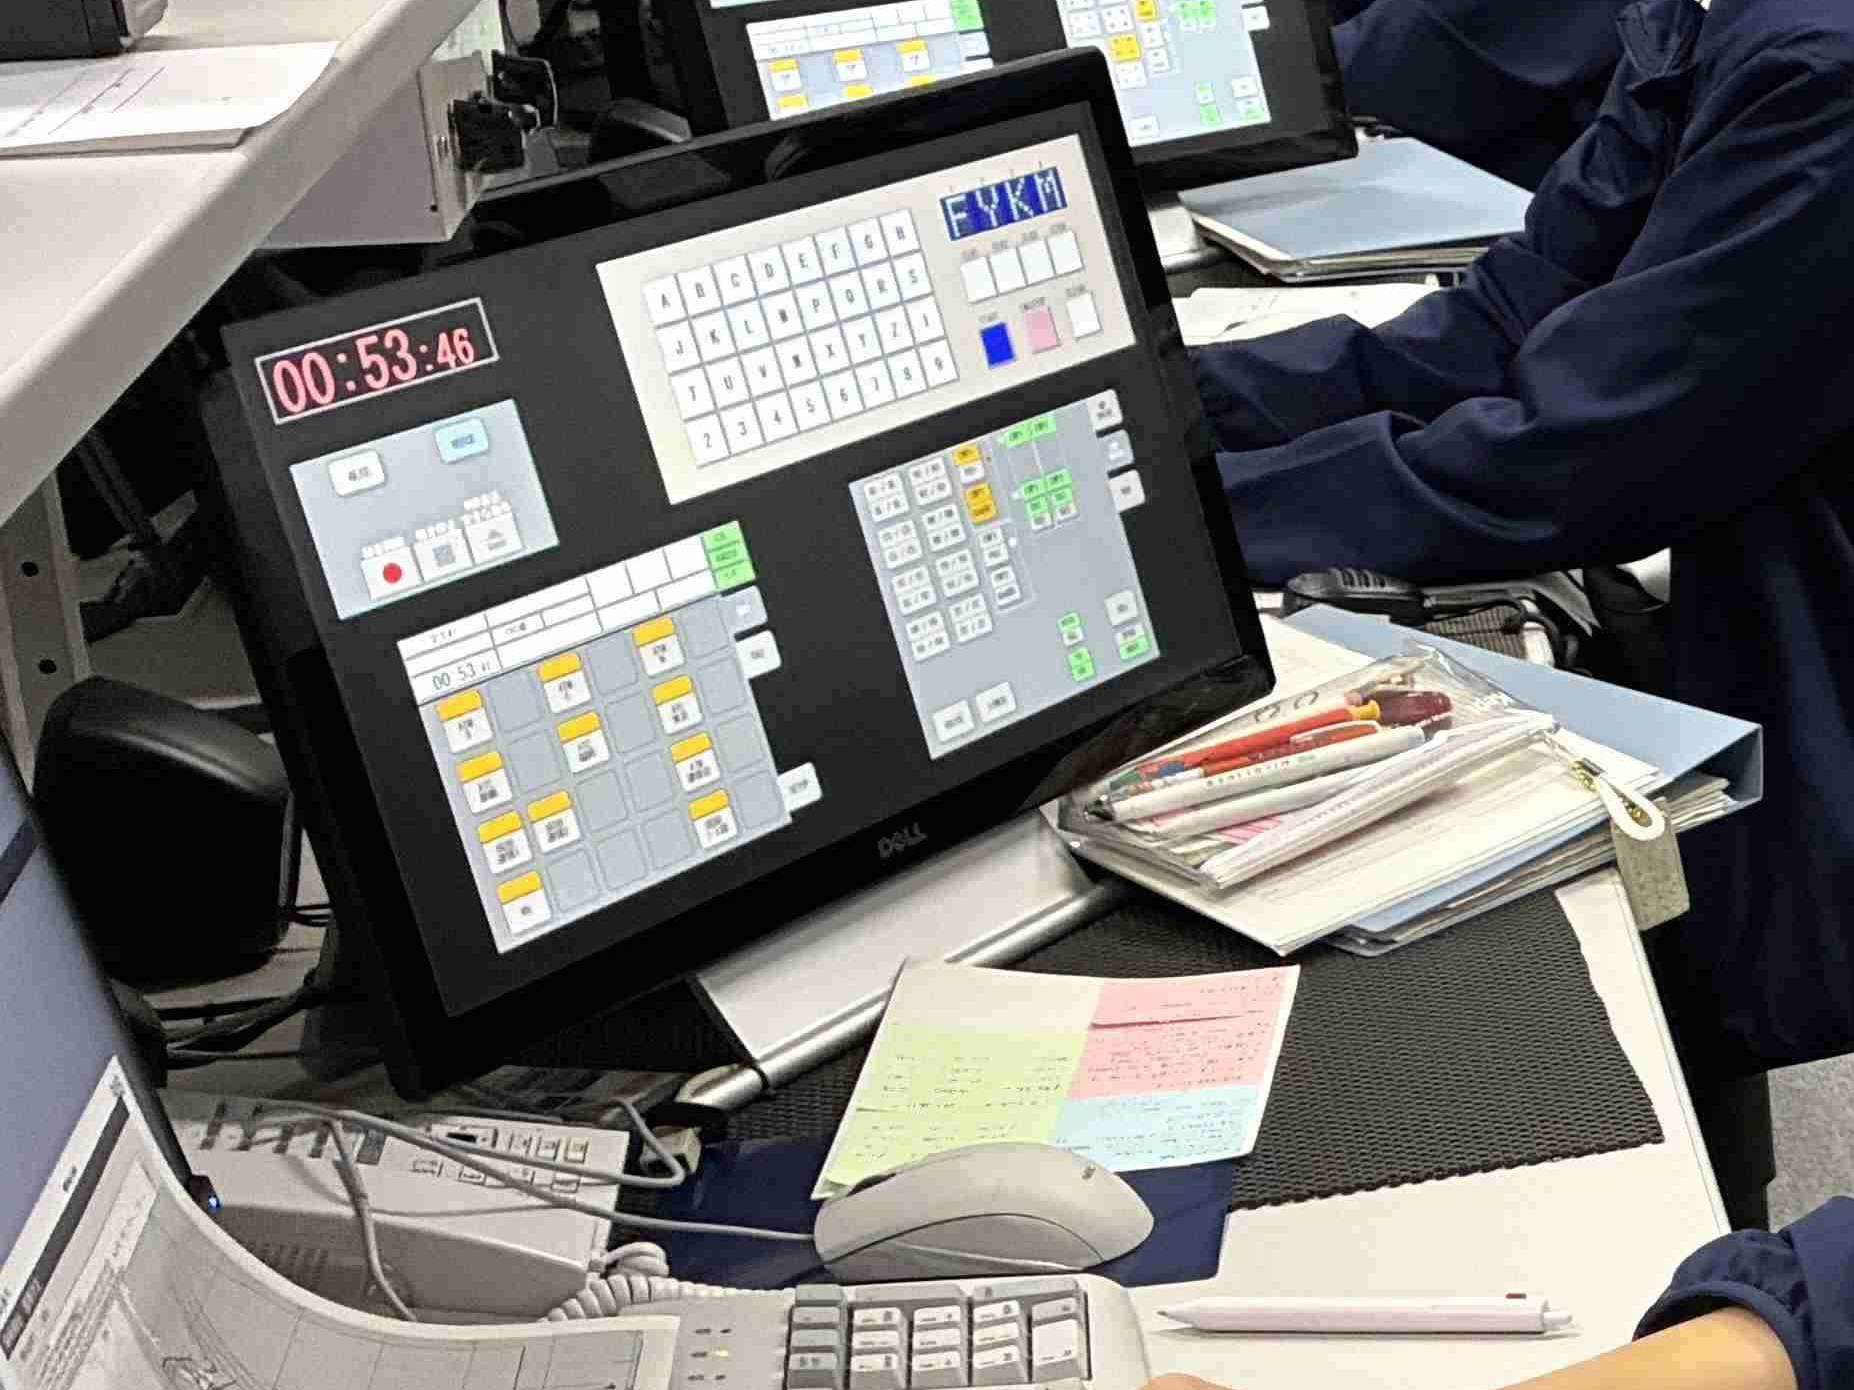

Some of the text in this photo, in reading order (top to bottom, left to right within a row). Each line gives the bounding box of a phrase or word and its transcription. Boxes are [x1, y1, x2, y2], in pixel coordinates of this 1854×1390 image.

[944, 166, 1068, 238] FYKM
[273, 328, 475, 413] 00:53:46
[877, 822, 928, 858] DELL
